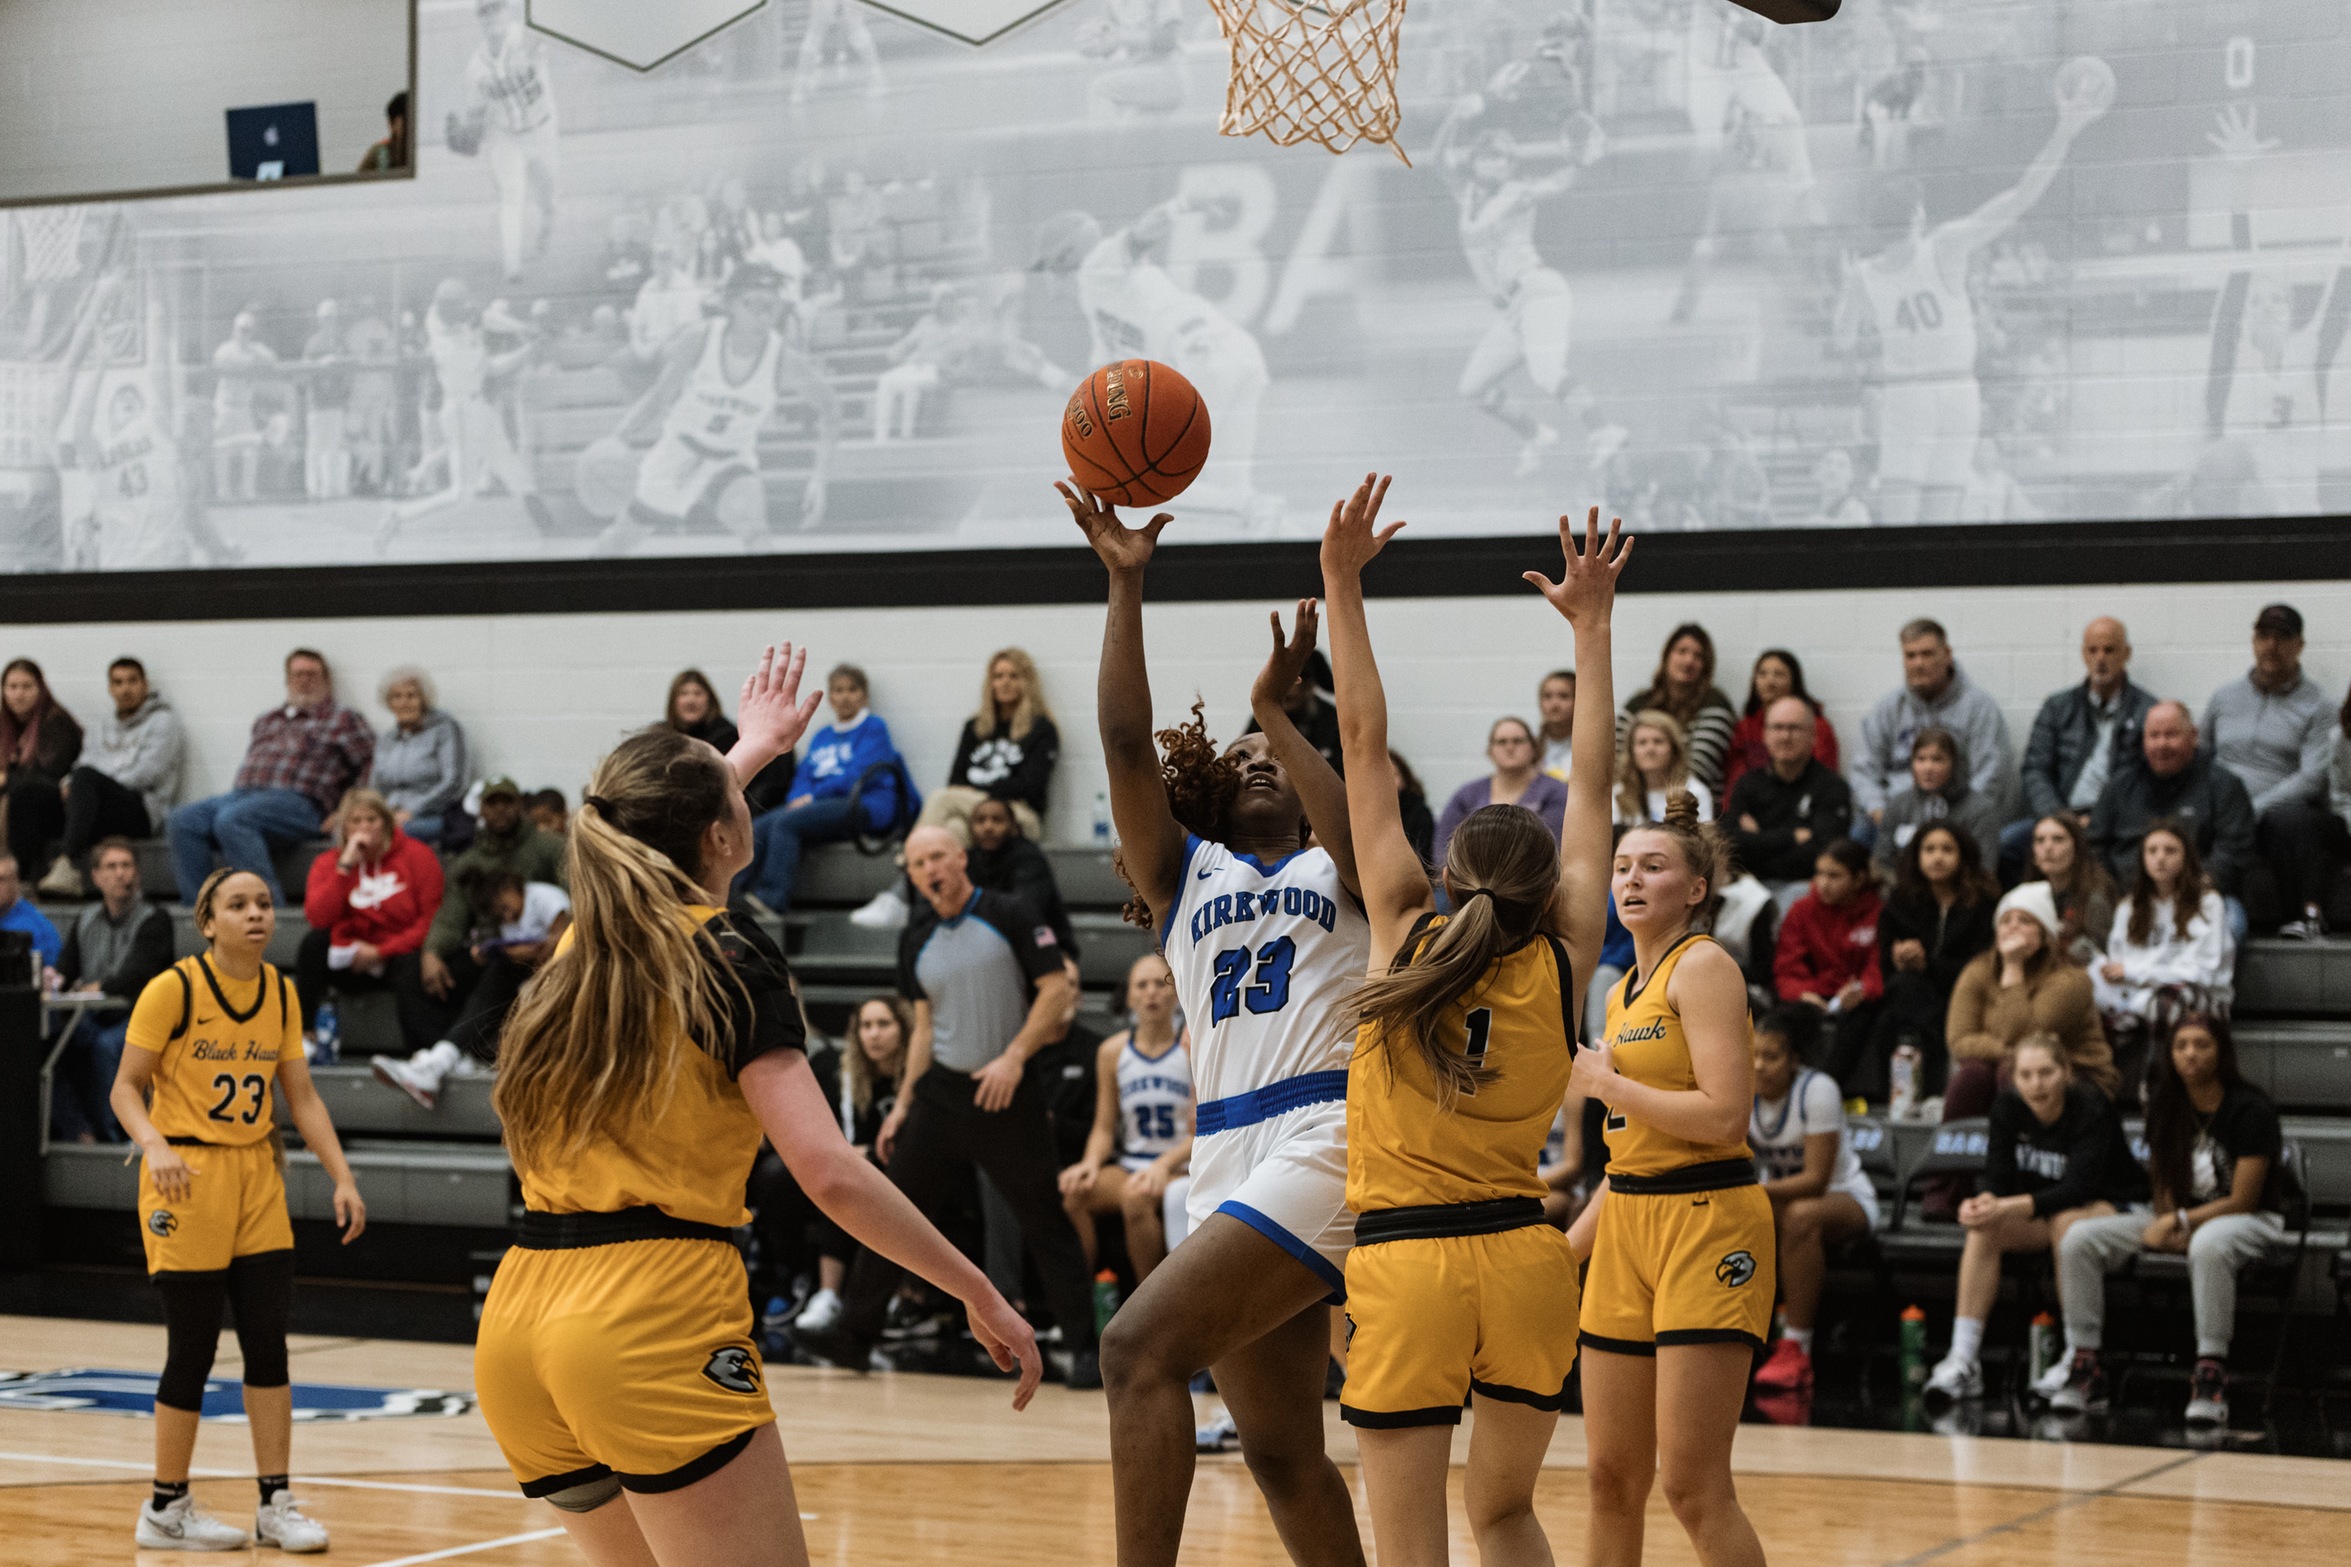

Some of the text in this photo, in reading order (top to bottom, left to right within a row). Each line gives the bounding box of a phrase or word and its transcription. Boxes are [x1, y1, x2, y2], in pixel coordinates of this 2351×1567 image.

[1896, 291, 1943, 333] 40
[1191, 887, 1336, 950] KIRKWOOD
[1211, 935, 1296, 1028] 23
[192, 1038, 280, 1061] Black Haw
[1456, 1006, 1492, 1098] 1
[1612, 1016, 1667, 1048] Hawk
[208, 1073, 265, 1124] 23
[1134, 1104, 1175, 1139] 25
